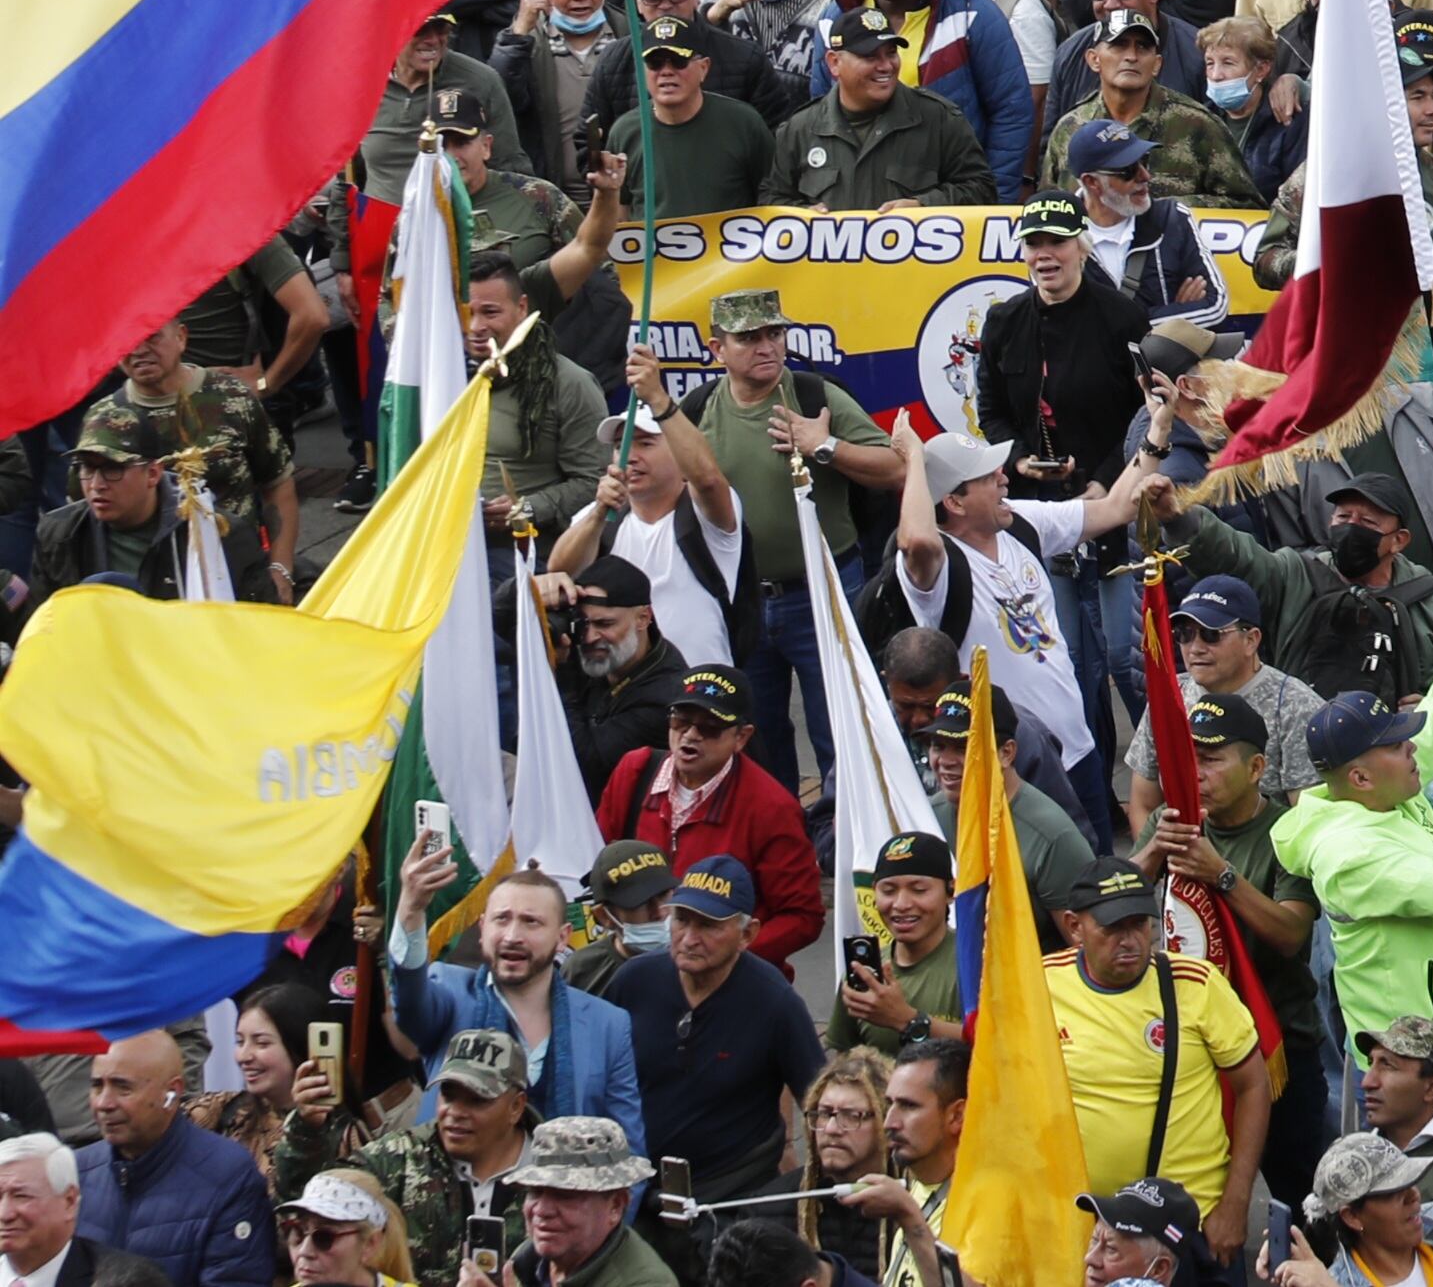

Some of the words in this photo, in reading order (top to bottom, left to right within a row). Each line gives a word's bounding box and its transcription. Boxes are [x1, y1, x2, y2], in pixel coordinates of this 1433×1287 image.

[721, 216, 964, 264] SOMOS
[683, 672, 736, 694] VETERANO
[608, 853, 667, 884] POLICIA
[683, 872, 732, 898] ARMADA
